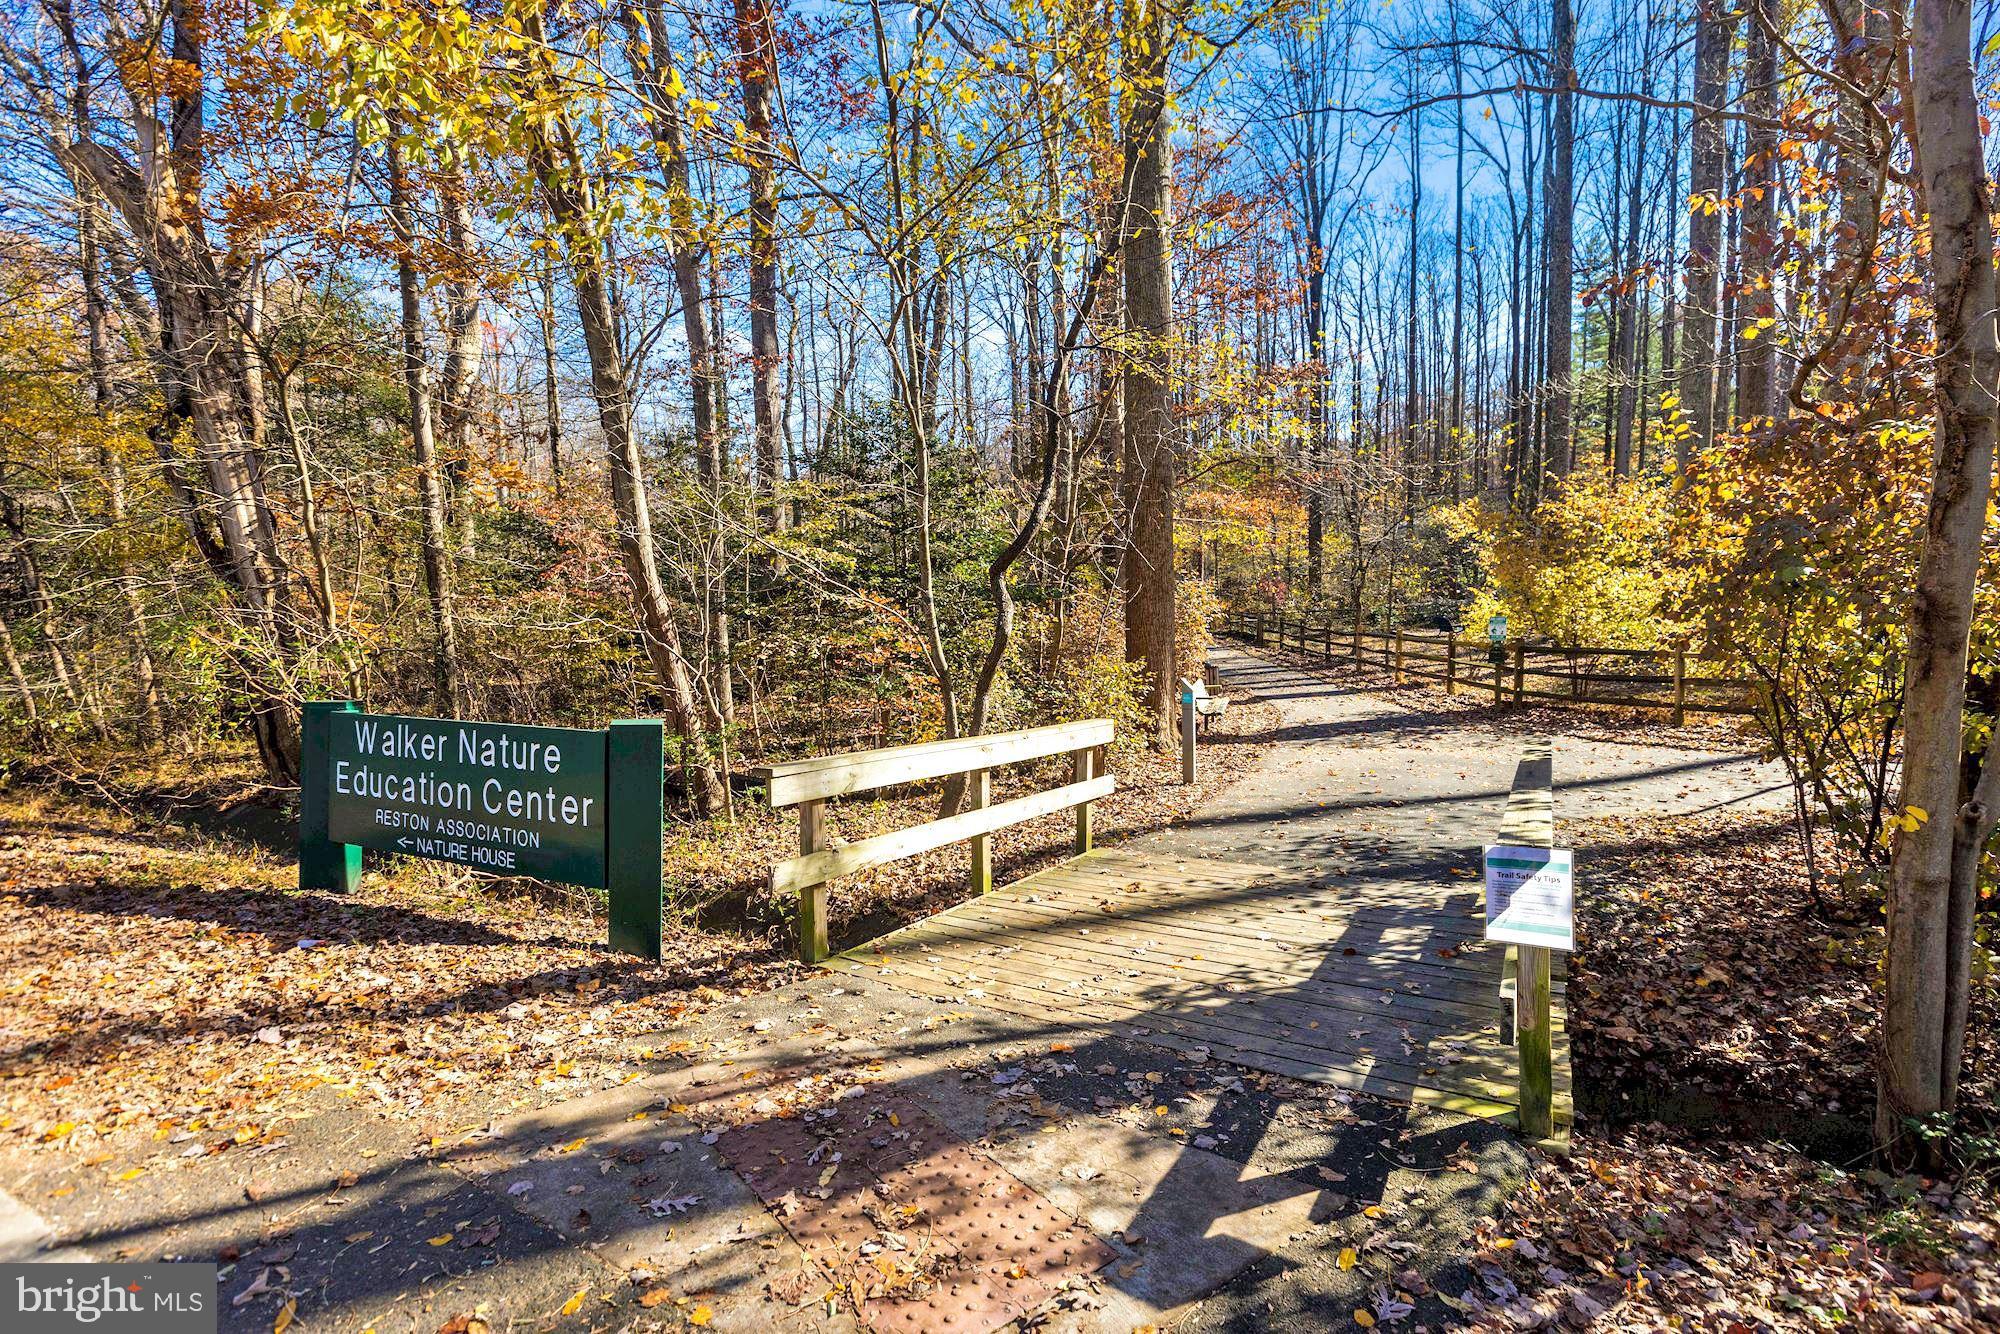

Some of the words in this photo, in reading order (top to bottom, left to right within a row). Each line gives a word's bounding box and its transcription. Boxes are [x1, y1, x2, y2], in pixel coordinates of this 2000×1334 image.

[355, 721, 447, 762] Walker
[459, 728, 561, 773] Nature
[336, 760, 472, 811] Education
[482, 778, 594, 827] Center
[375, 808, 429, 831] RESTON
[436, 818, 540, 848] ASSOCIATION
[417, 838, 467, 861] NATURE
[471, 847, 516, 869] HOUSE
[1497, 871, 1514, 879] Trail
[1515, 872, 1542, 882] Safety
[1543, 875, 1561, 884] Tips
